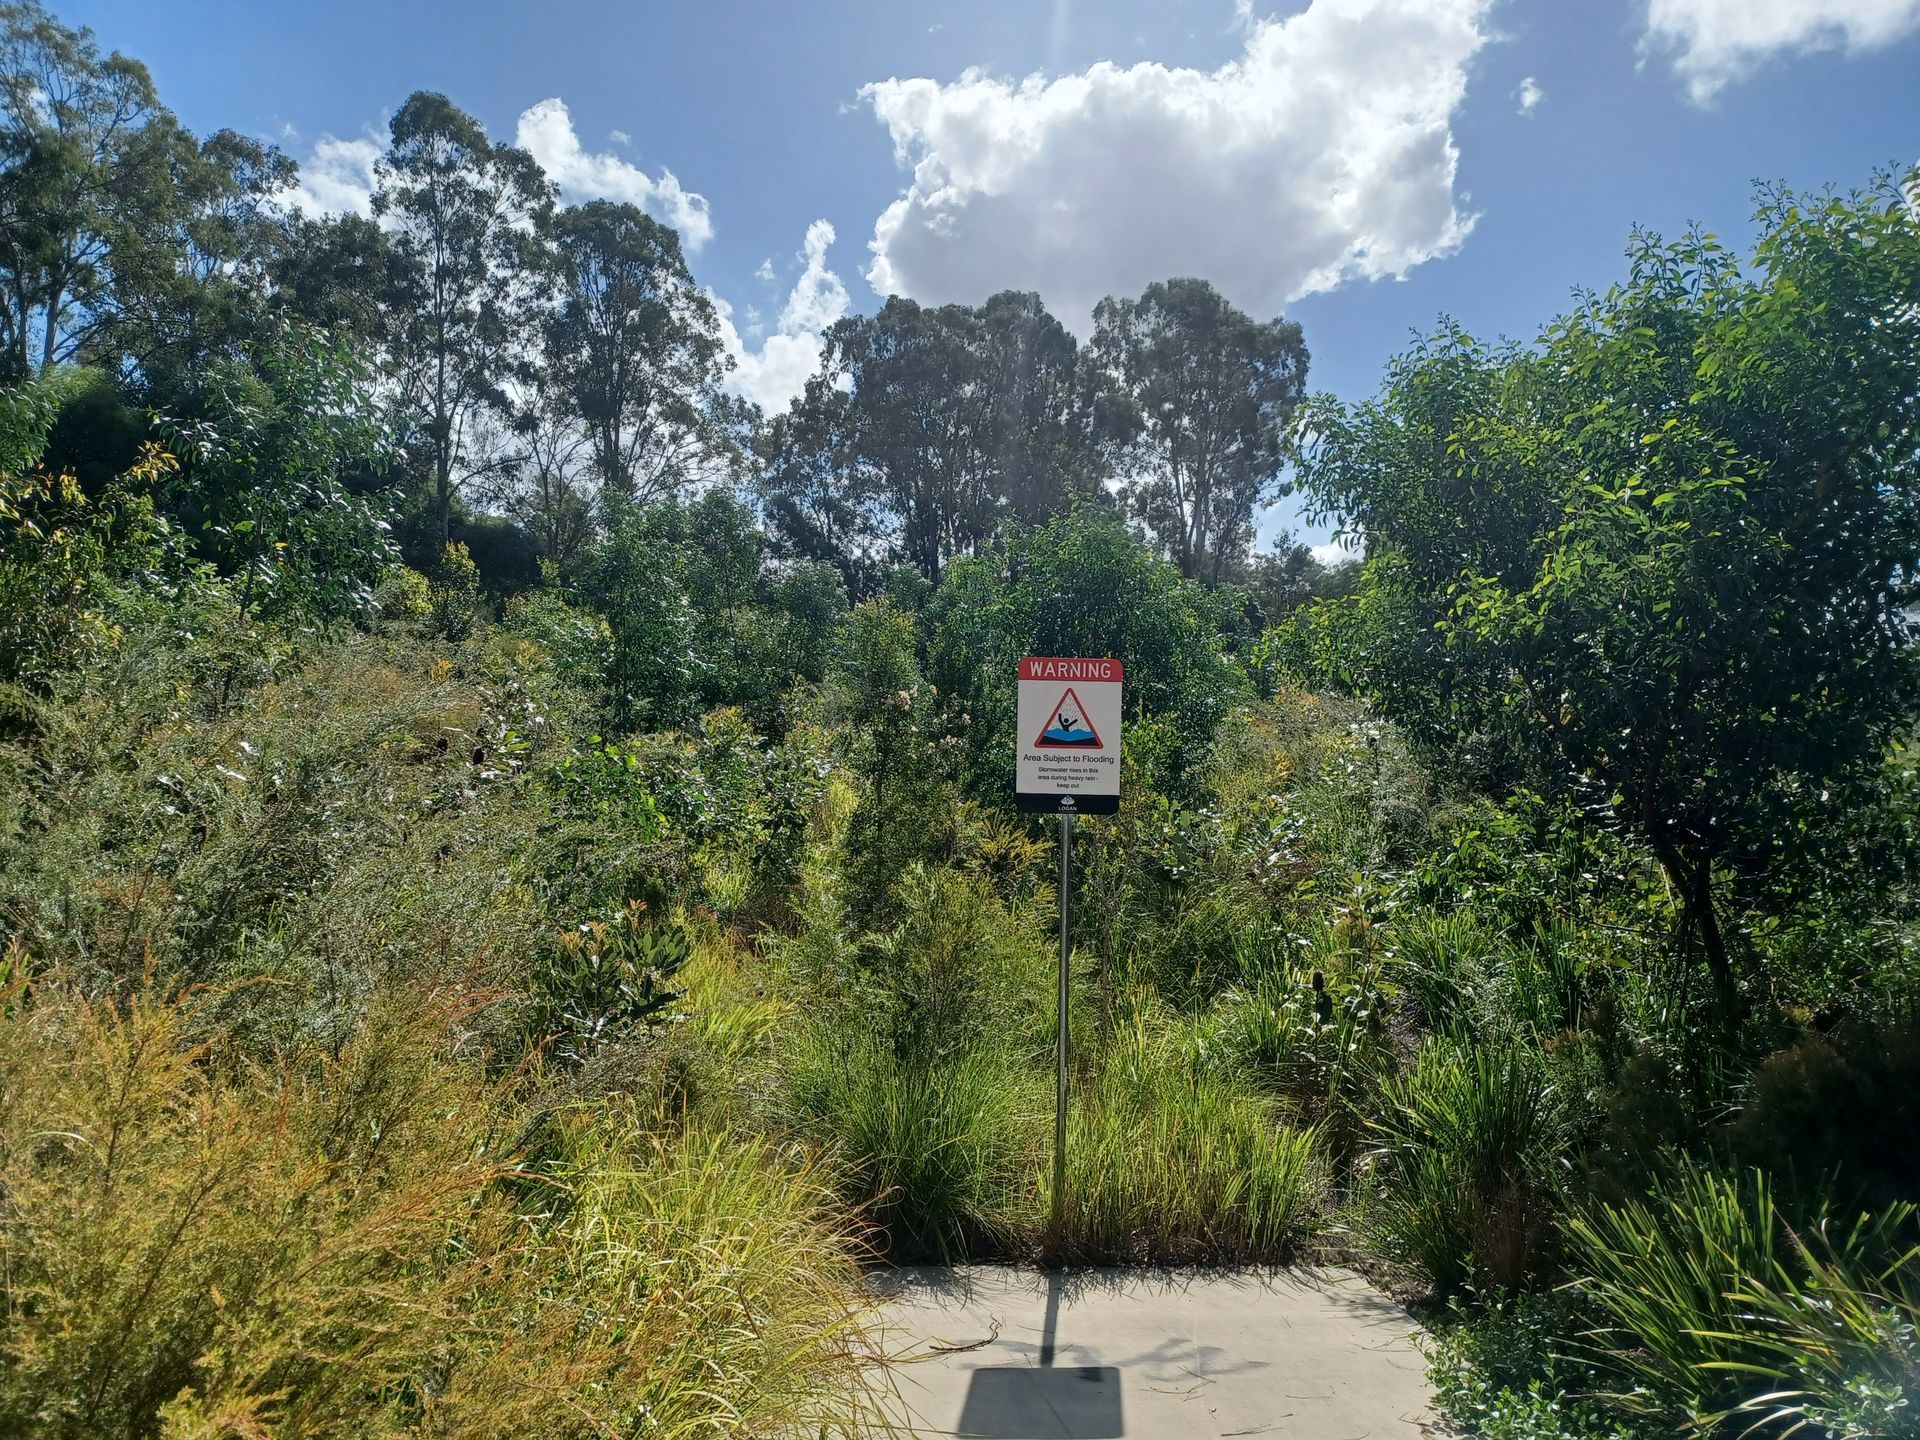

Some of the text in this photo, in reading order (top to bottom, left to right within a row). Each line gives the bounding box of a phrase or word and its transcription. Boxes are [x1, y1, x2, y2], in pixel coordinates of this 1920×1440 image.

[1030, 661, 1111, 678] WARNING
[1043, 754, 1071, 764] Subject
[1082, 756, 1114, 764] Flooding
